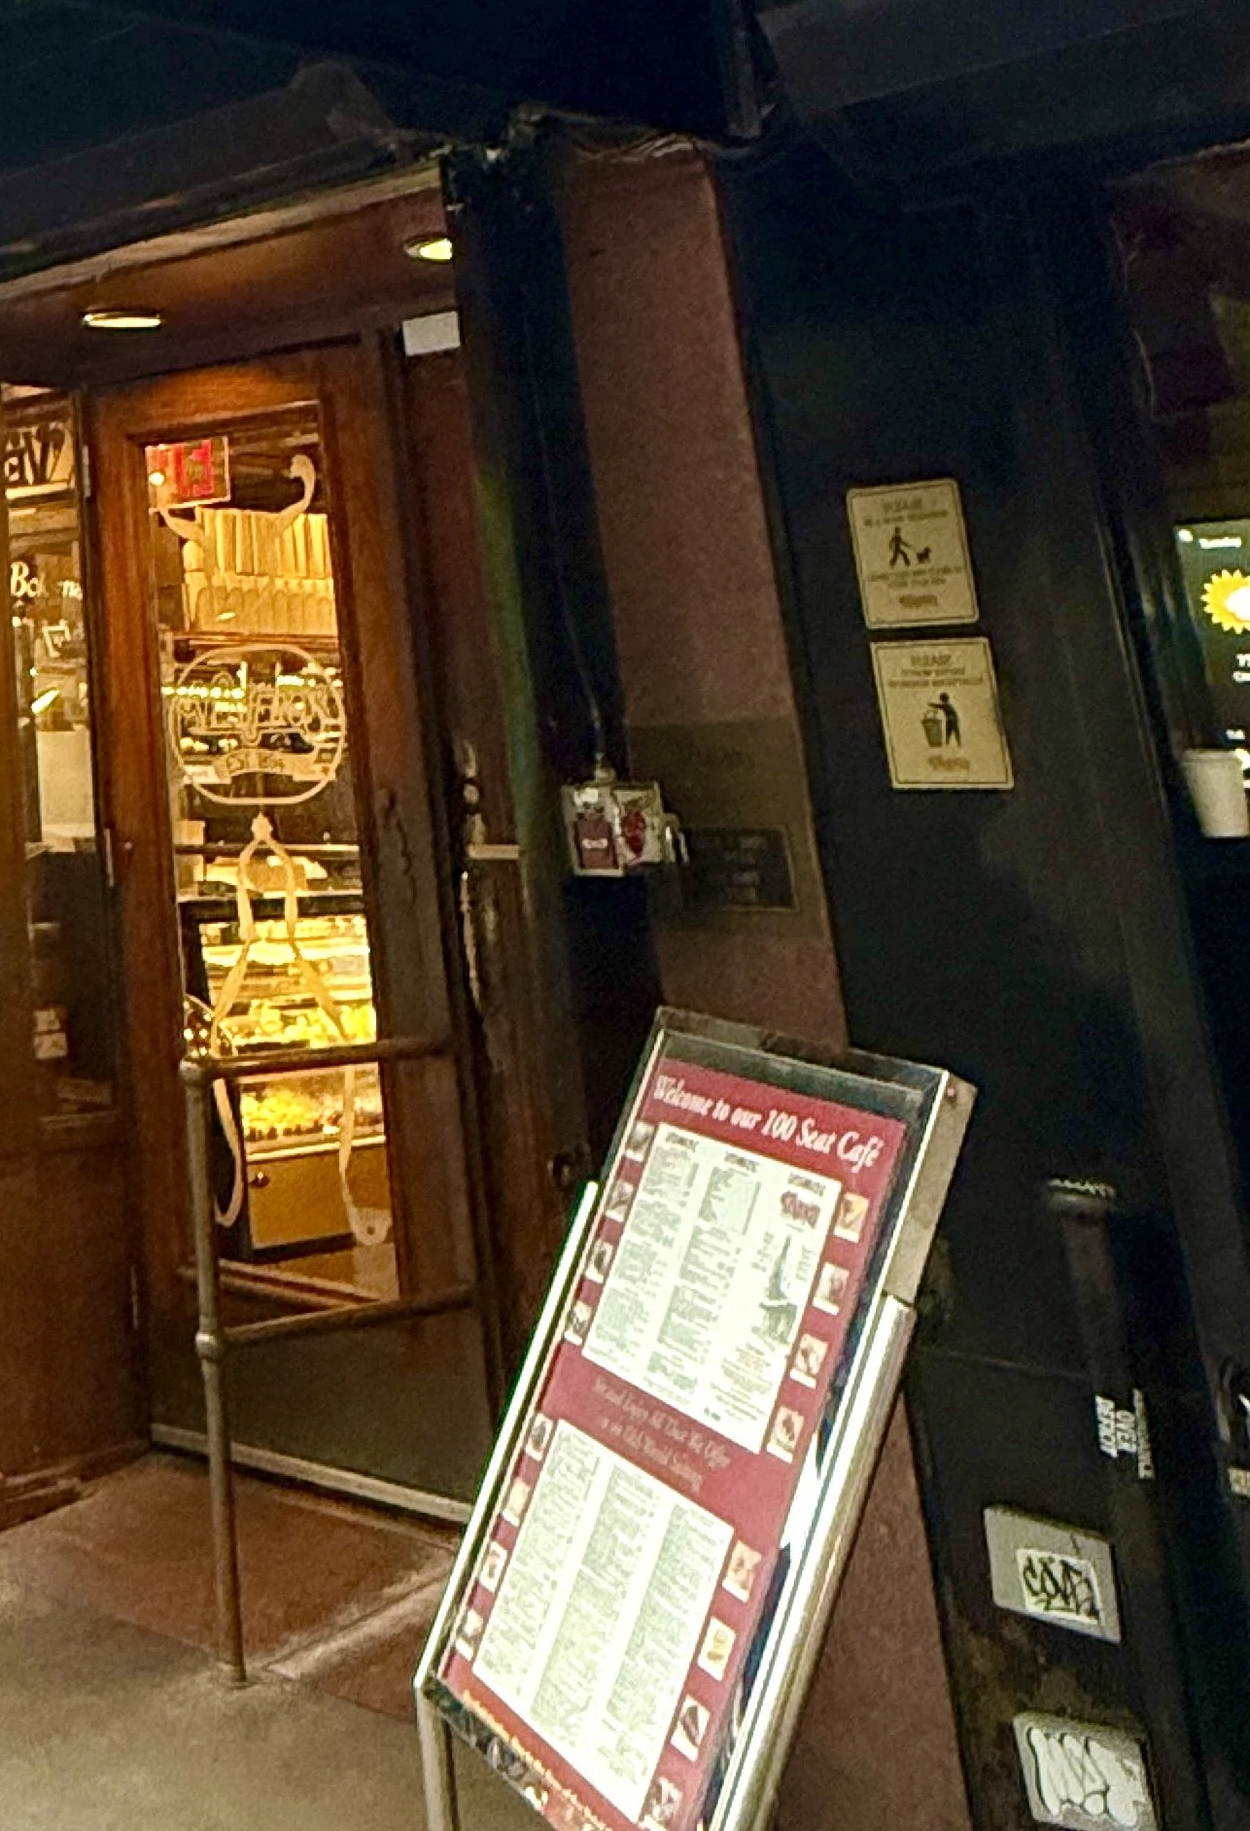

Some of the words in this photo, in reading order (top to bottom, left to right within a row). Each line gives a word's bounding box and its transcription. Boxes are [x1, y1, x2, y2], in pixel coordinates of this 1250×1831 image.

[653, 1075, 715, 1117] Welcome
[712, 1099, 732, 1121] to
[730, 1108, 763, 1130] our
[761, 1109, 798, 1142] 100
[796, 1118, 838, 1154] Seat
